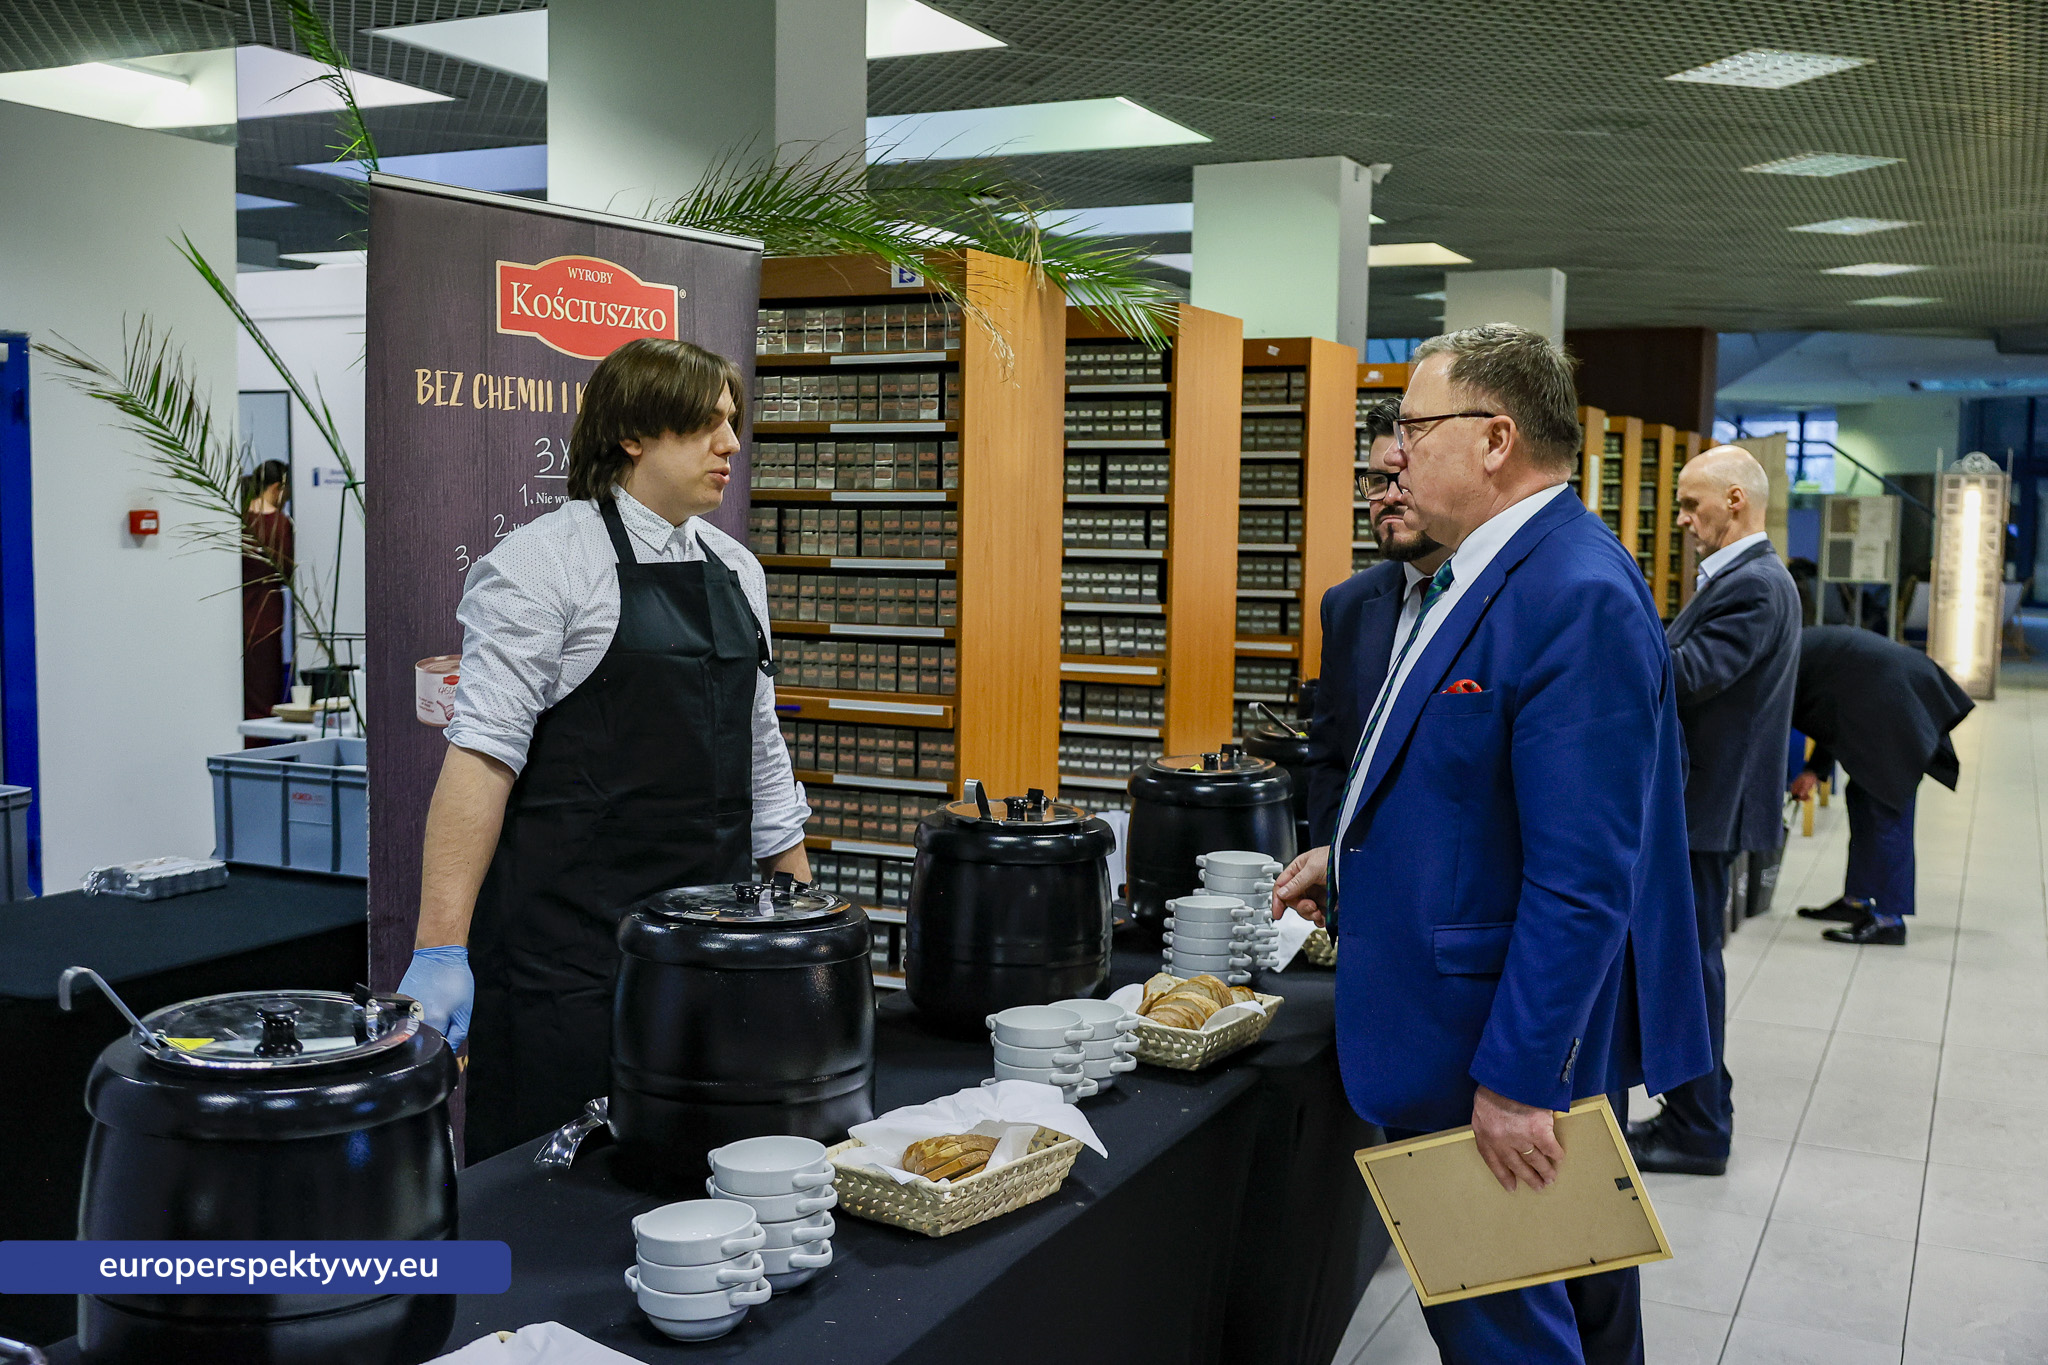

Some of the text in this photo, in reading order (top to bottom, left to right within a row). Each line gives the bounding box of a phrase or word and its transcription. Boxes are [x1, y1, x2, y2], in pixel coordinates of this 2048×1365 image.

[568, 266, 614, 285] WYROBY
[510, 281, 667, 332] KOŚCIUSZKO
[415, 368, 588, 415] BEZ CHEMII I K
[518, 483, 534, 507] 1.
[536, 492, 553, 504] Nie
